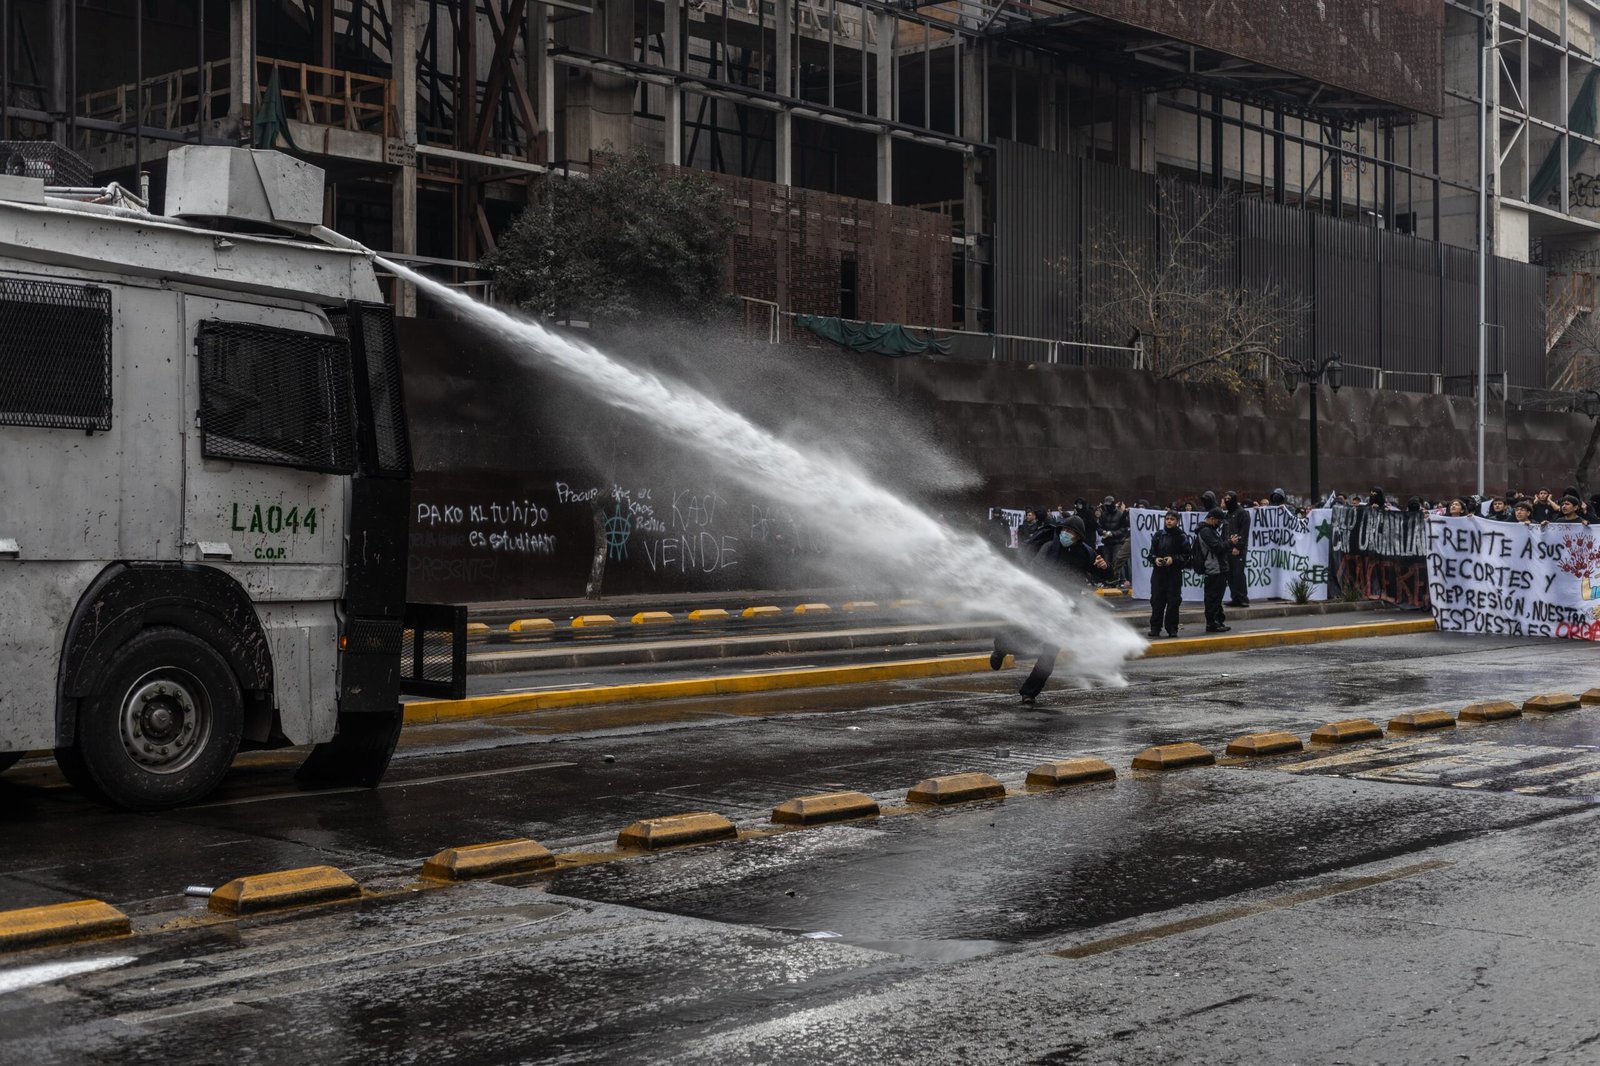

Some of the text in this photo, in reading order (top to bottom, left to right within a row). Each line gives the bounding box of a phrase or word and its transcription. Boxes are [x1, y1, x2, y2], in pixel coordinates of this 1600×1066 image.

[231, 503, 317, 535] LA044
[255, 547, 287, 559] C.O.P.
[644, 531, 738, 573] VENDE
[1427, 519, 1513, 557] FRENTE
[1520, 538, 1532, 559] A
[1537, 542, 1565, 561] SUS
[1427, 553, 1556, 593] RECORTES Y
[1432, 604, 1522, 636] RESPUESTA
[1528, 624, 1551, 638] ES
[1533, 601, 1586, 625] NUESTRA
